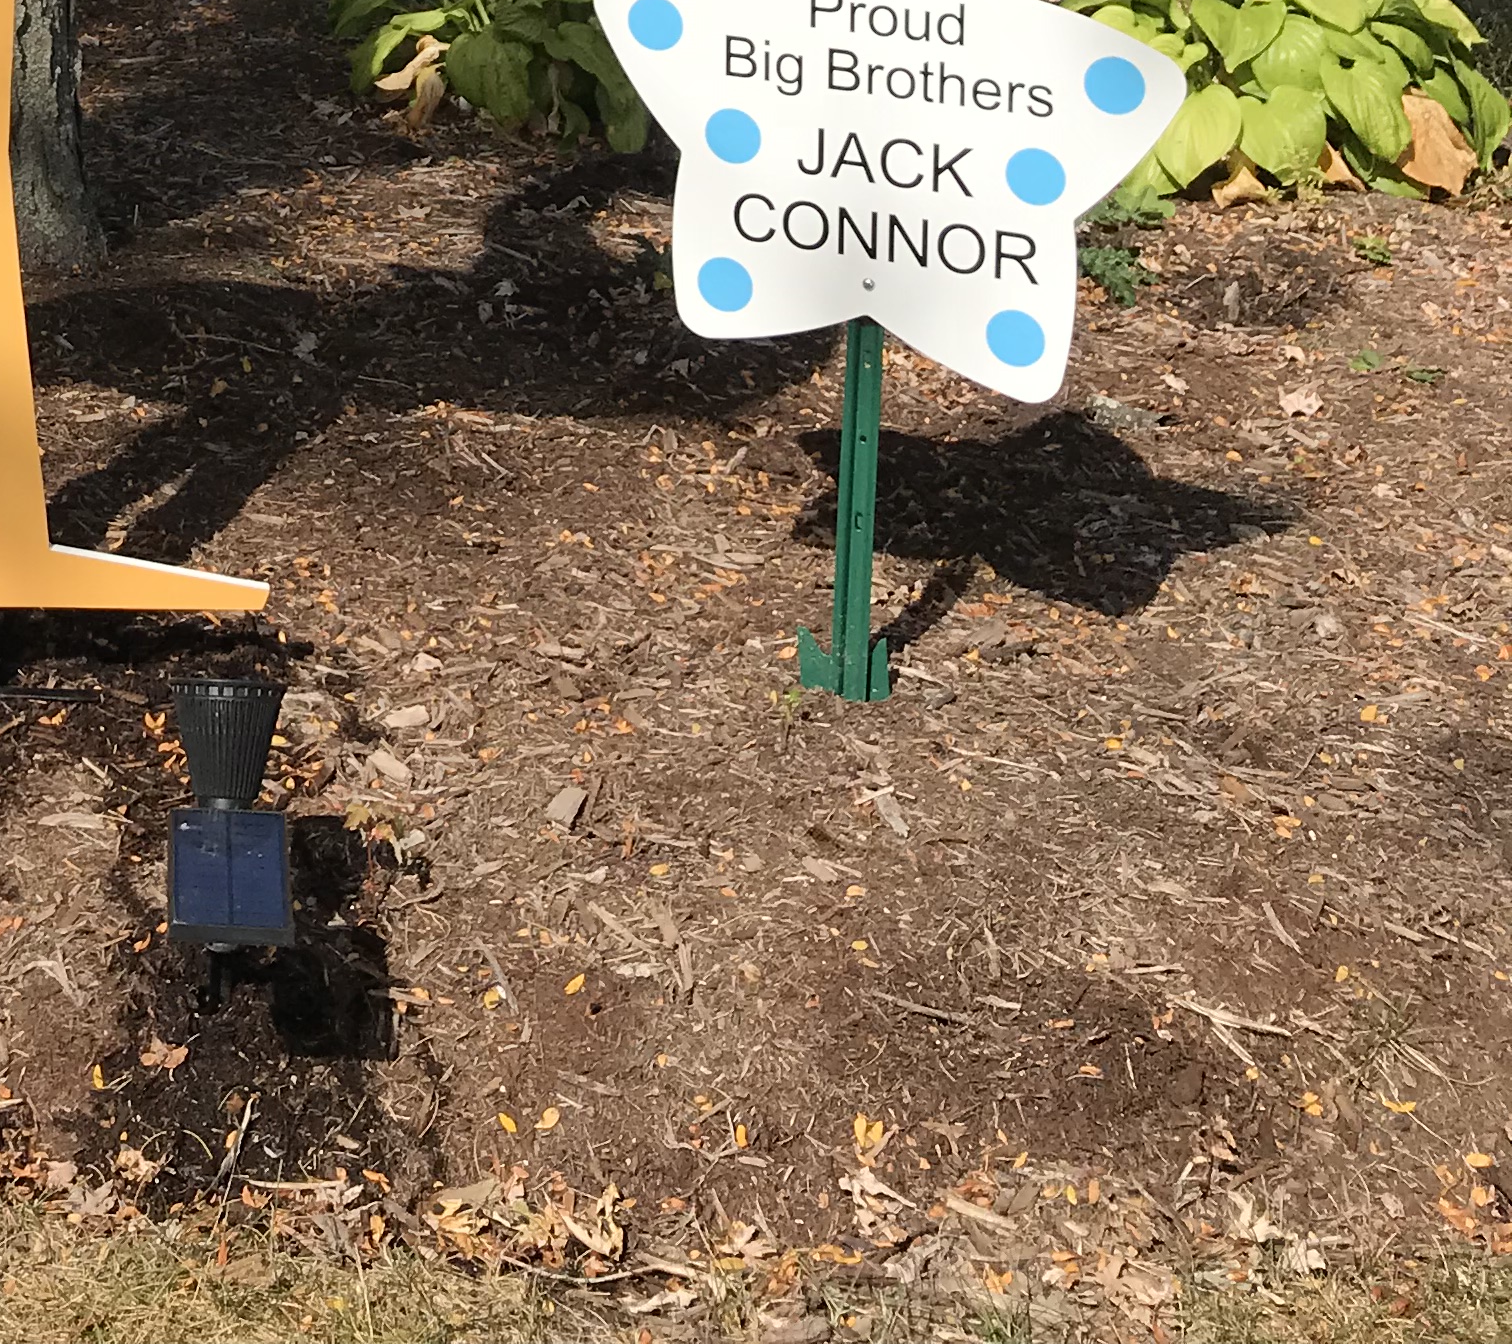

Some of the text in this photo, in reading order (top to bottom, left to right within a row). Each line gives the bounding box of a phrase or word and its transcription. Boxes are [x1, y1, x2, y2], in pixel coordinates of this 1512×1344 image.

[725, 35, 1053, 118] Big Brothers
[797, 128, 972, 197] JACK
[733, 191, 1038, 285] CONNOR
